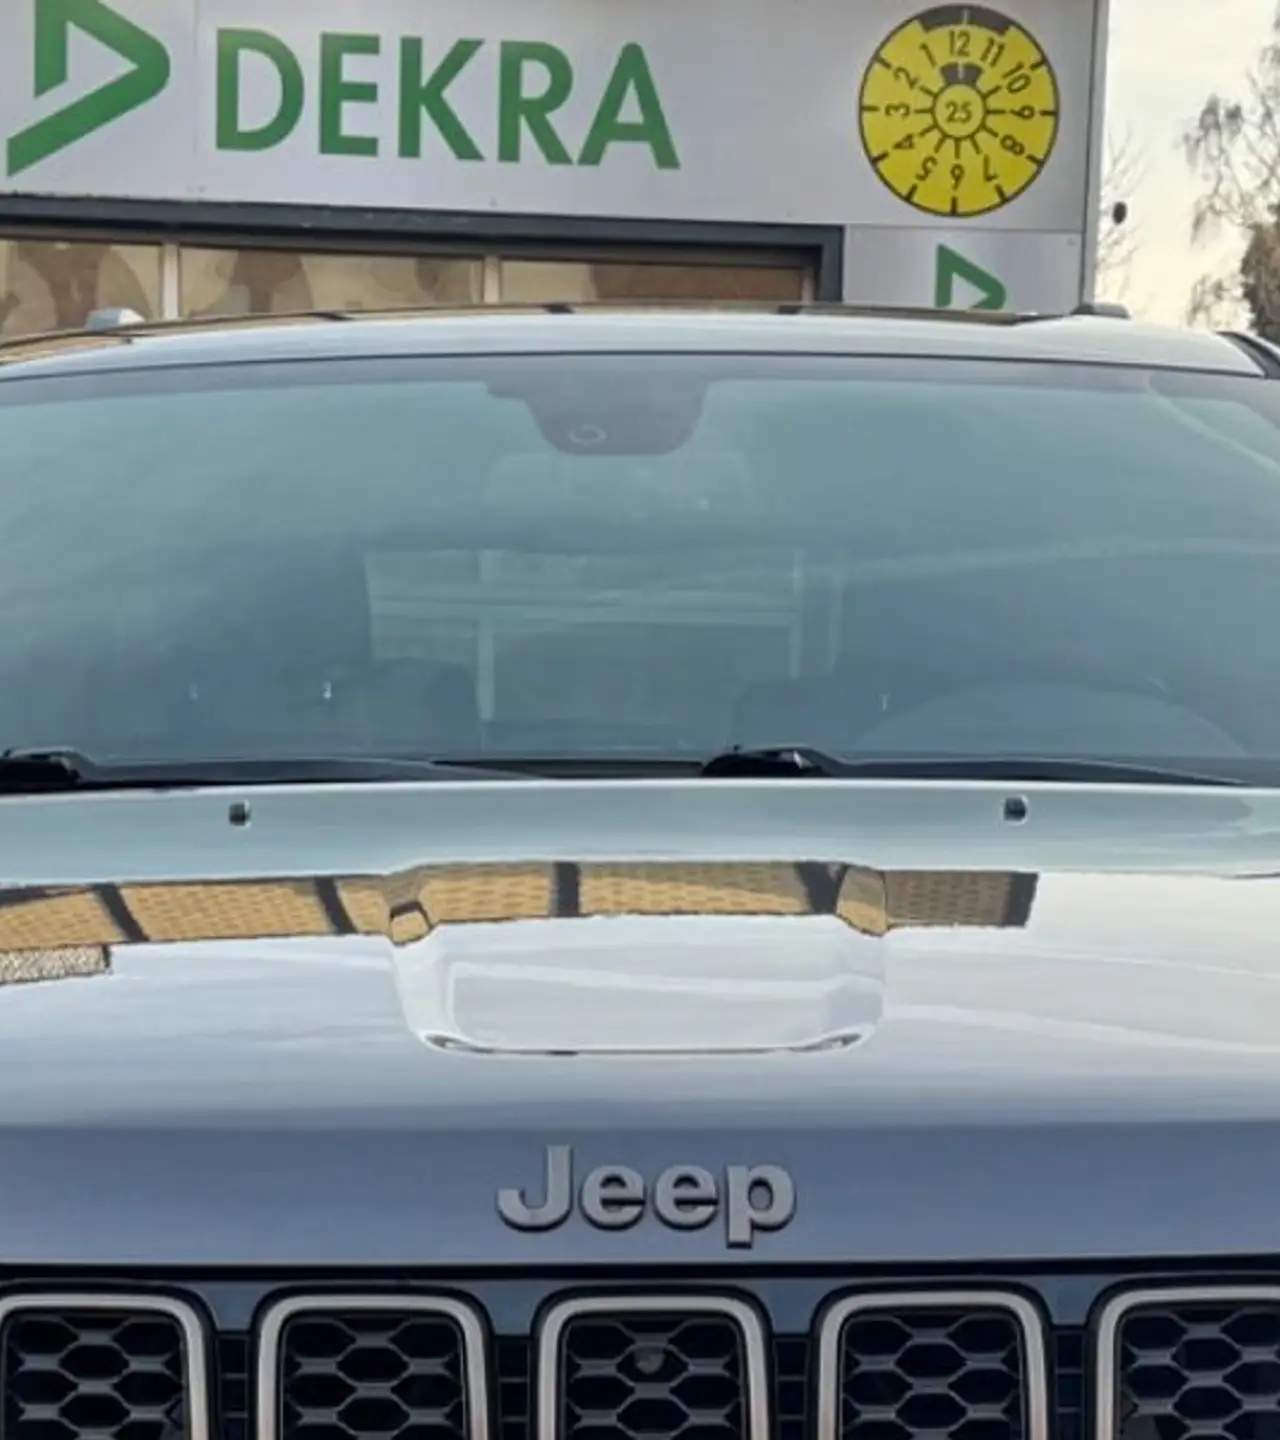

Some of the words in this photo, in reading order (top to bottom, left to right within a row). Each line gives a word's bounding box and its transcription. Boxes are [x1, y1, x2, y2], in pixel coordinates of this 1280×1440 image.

[920, 43, 937, 68] 1
[949, 30, 970, 57] 12
[980, 37, 1005, 68] 11
[893, 66, 919, 90] 2
[1001, 61, 1031, 94] 10
[216, 27, 680, 169] DEKRA
[885, 103, 910, 119] 3
[945, 101, 972, 124] 25
[892, 133, 915, 150] 4
[1000, 134, 1025, 157] 8
[915, 156, 938, 182] 5
[497, 1143, 796, 1250] Jeep
